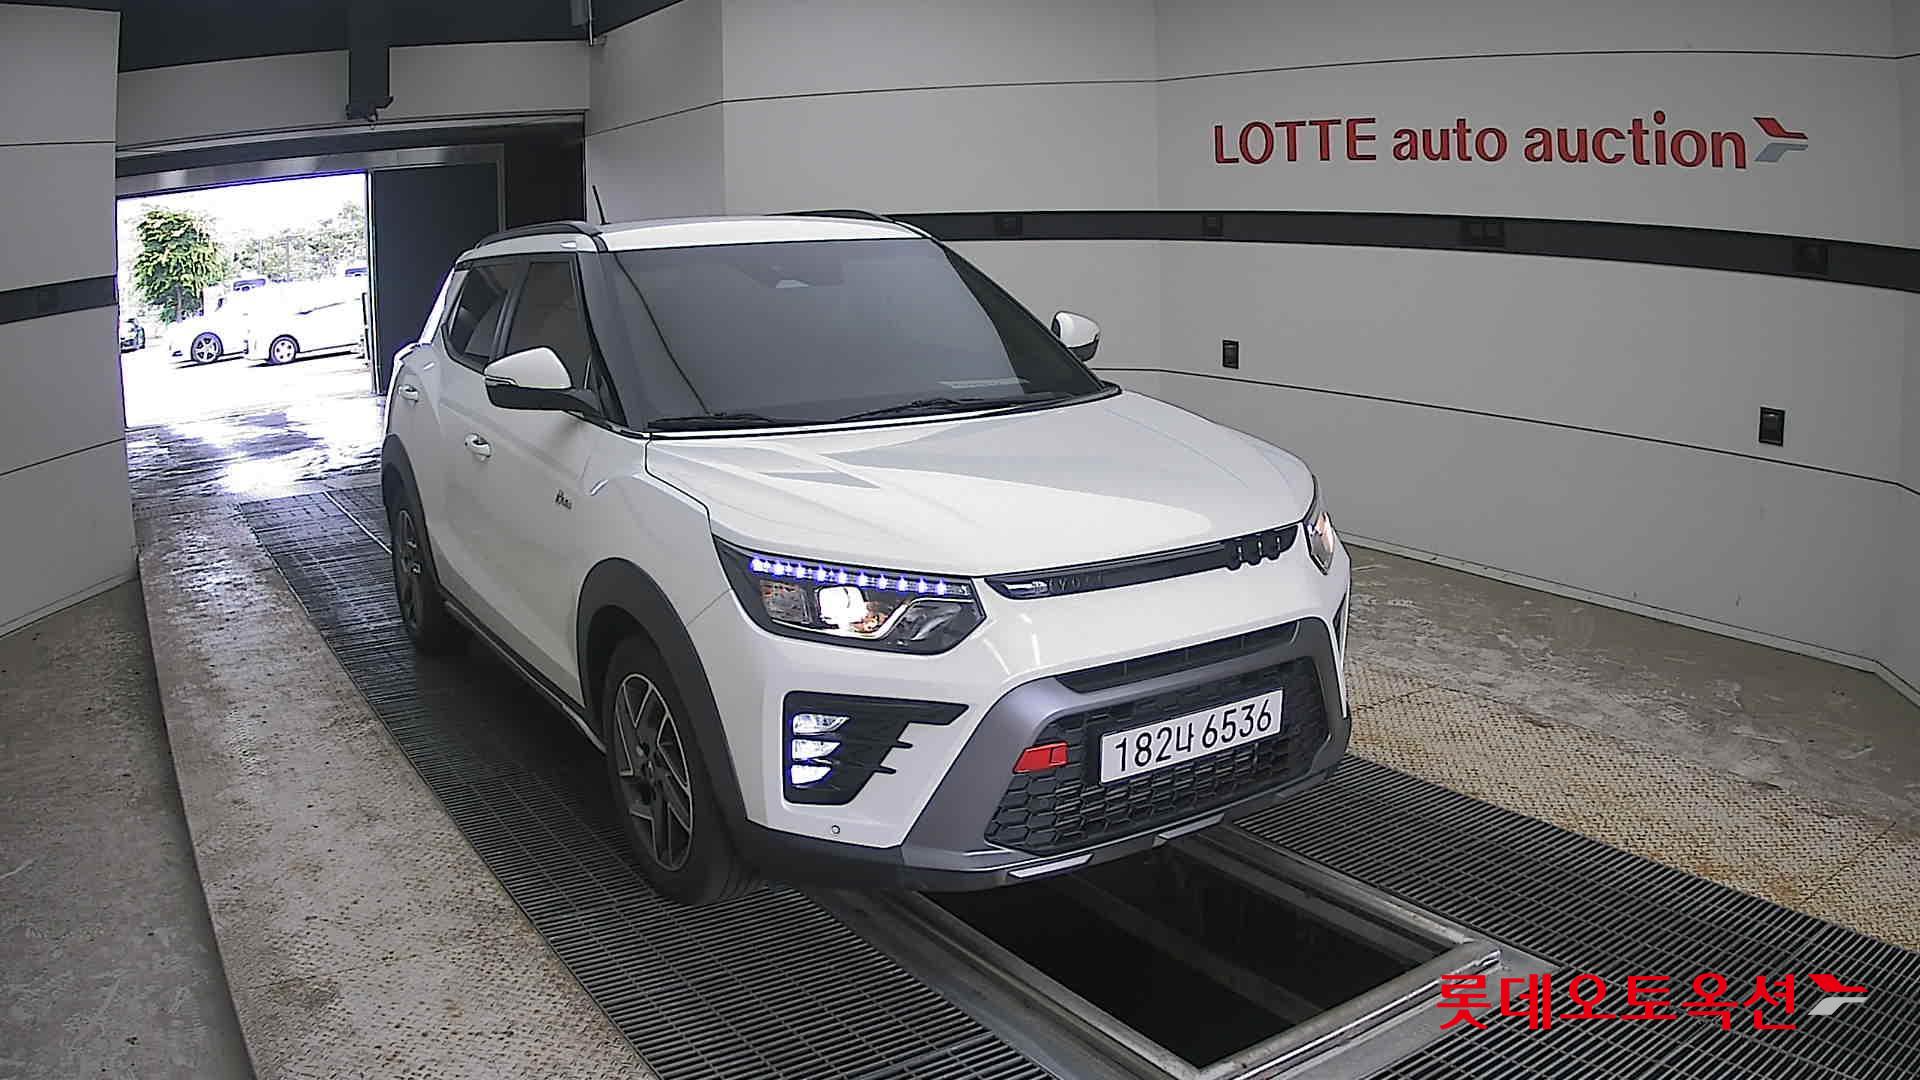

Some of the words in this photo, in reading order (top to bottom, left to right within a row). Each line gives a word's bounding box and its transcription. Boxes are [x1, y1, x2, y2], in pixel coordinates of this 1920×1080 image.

[1214, 116, 1376, 164] LOTTE
[1392, 118, 1508, 162] auto
[1523, 110, 1747, 169] auction
[1115, 722, 1195, 772] 182나
[1202, 699, 1272, 748] 6536
